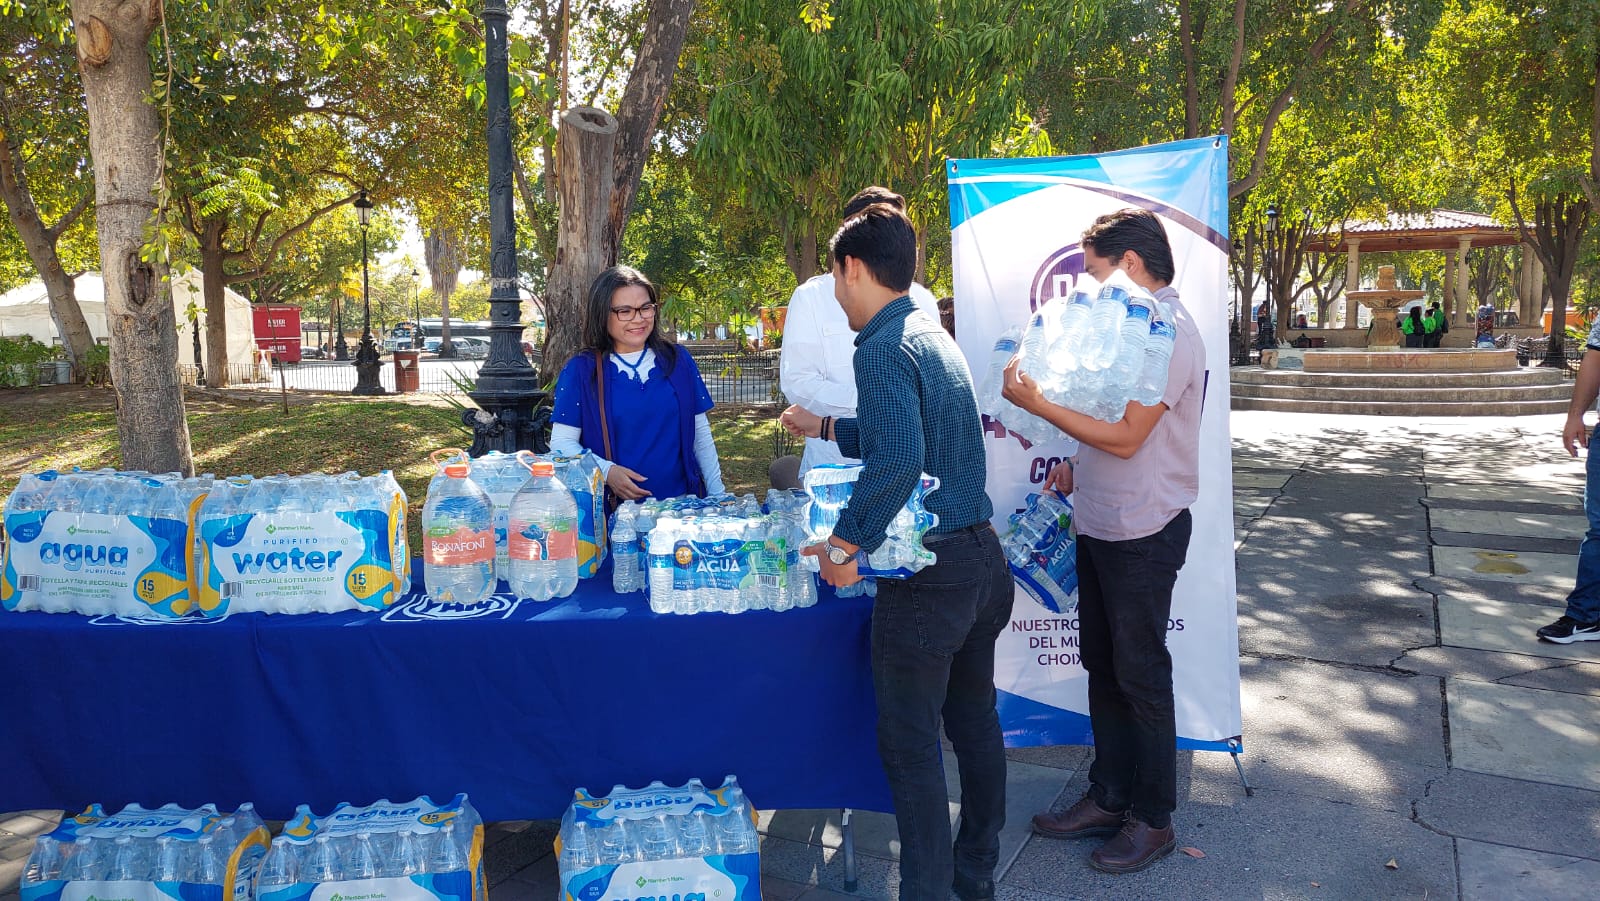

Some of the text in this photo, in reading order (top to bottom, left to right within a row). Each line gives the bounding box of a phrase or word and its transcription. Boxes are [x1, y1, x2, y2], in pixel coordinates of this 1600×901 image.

[431, 536, 486, 553] BONAFONT
[1050, 538, 1074, 566] AGUA
[40, 542, 129, 571] agua
[232, 547, 343, 575] water
[696, 558, 741, 573] AGUA
[142, 579, 155, 591] 15
[351, 573, 366, 585] 15
[1029, 637, 1057, 649] DEL
[335, 807, 421, 821] agua
